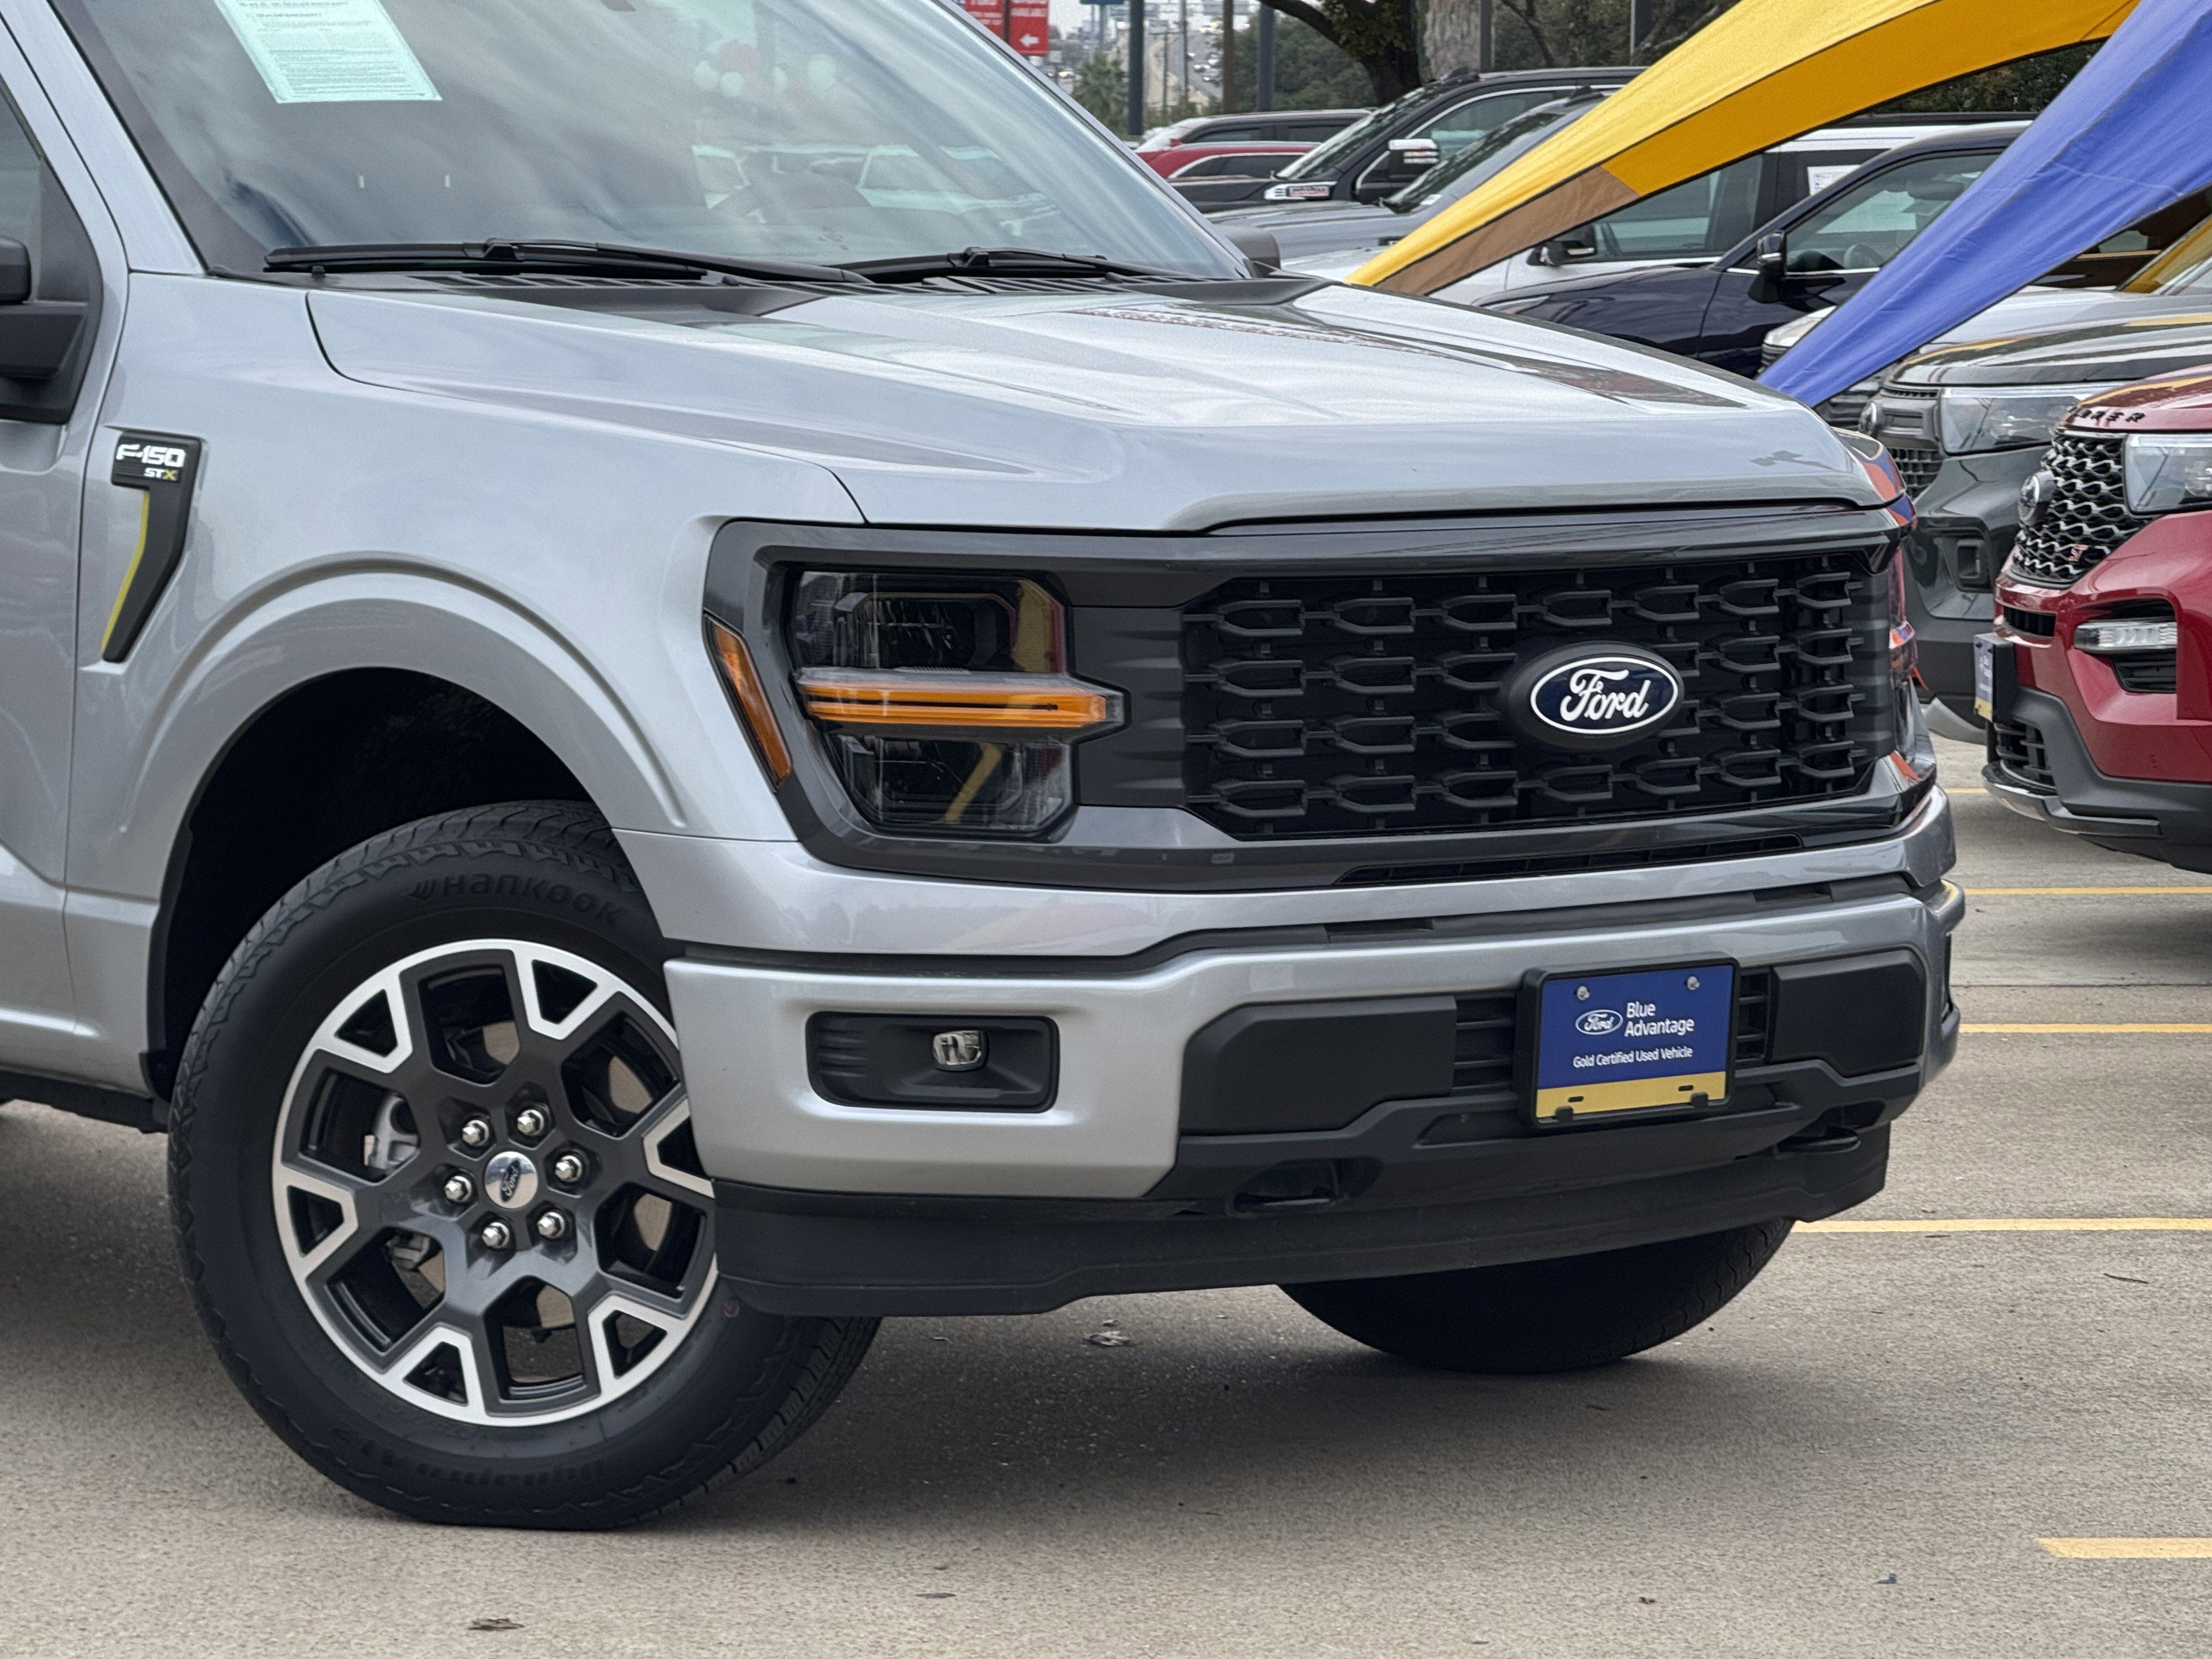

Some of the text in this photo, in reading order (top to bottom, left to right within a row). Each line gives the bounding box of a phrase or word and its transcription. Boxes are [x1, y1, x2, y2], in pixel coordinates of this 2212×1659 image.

[116, 444, 185, 467] F-150
[144, 467, 178, 480] STX
[1560, 668, 1651, 721] Ford
[1627, 1001, 1656, 1018] Blue
[1584, 1013, 1615, 1031] Ford
[1624, 1018, 1695, 1037] Advantage
[1573, 1045, 1694, 1068] Gold Certified Used Vehicle
